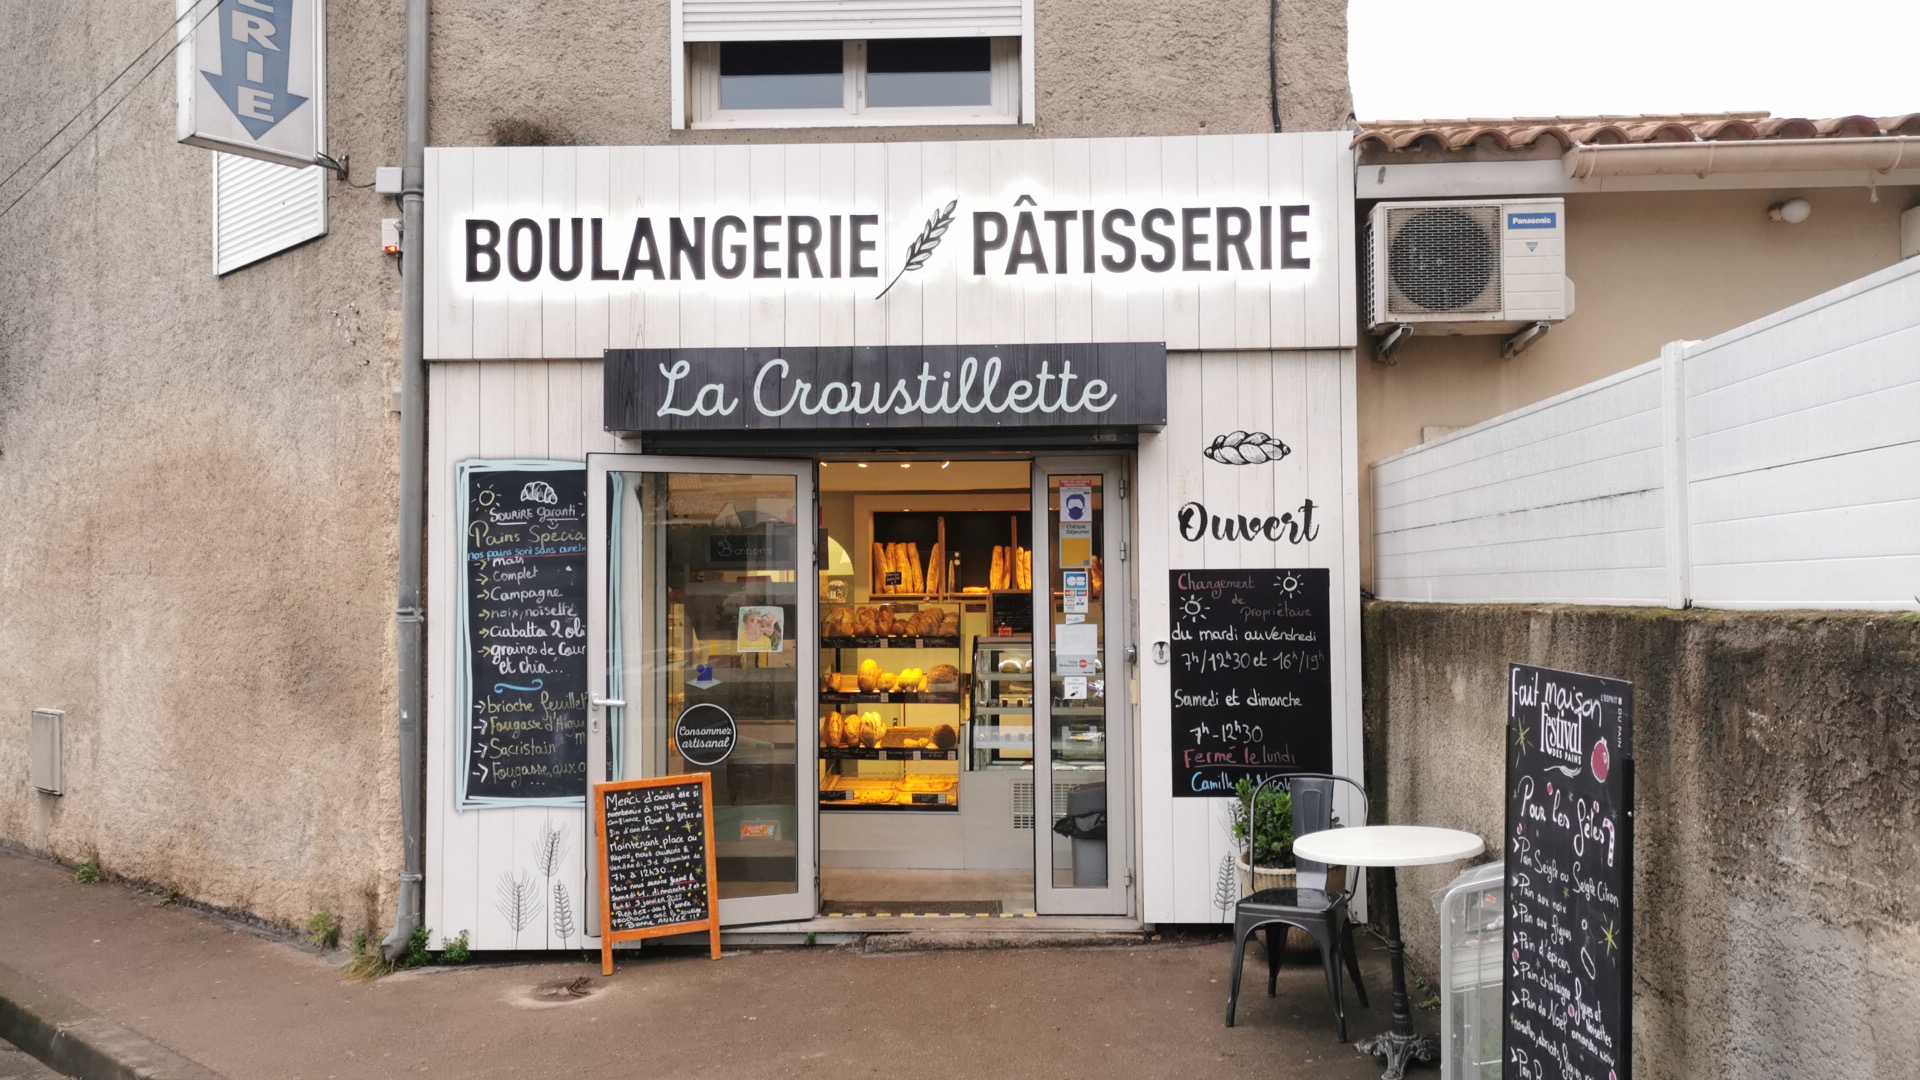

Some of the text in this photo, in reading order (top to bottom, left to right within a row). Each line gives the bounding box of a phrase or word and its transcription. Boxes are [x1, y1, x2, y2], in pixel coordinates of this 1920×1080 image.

[231, 0, 281, 123] RIE
[1512, 217, 1552, 226] Panasonic
[465, 194, 1311, 282] BOULANGERIE PÂTISSERIE
[656, 356, 1118, 417] La Croustillette
[536, 504, 576, 522] garanti
[1178, 498, 1320, 545] Ouvert
[469, 520, 521, 548] Pains
[1178, 572, 1256, 599] Changement
[1231, 592, 1246, 605] de
[1240, 600, 1312, 623] propriétaire
[1171, 622, 1193, 641] du
[1199, 624, 1238, 642] mardi
[540, 641, 556, 655] de
[499, 661, 517, 675] et
[1253, 655, 1268, 668] et
[487, 694, 535, 714] brioche
[1174, 688, 1303, 708] Samedi et dimanche
[1512, 667, 1602, 727] Fait maison
[490, 716, 543, 740] Fougasse
[679, 726, 733, 736] Consommez
[1540, 702, 1583, 755] Festival
[489, 737, 557, 759] Sacristain
[682, 737, 730, 749] artisanal
[1183, 743, 1296, 768] Fermé le lundi
[1552, 750, 1582, 765] DES PAINS
[609, 837, 660, 852] Maintenant
[662, 834, 685, 849] place
[1519, 873, 1534, 900] Pain
